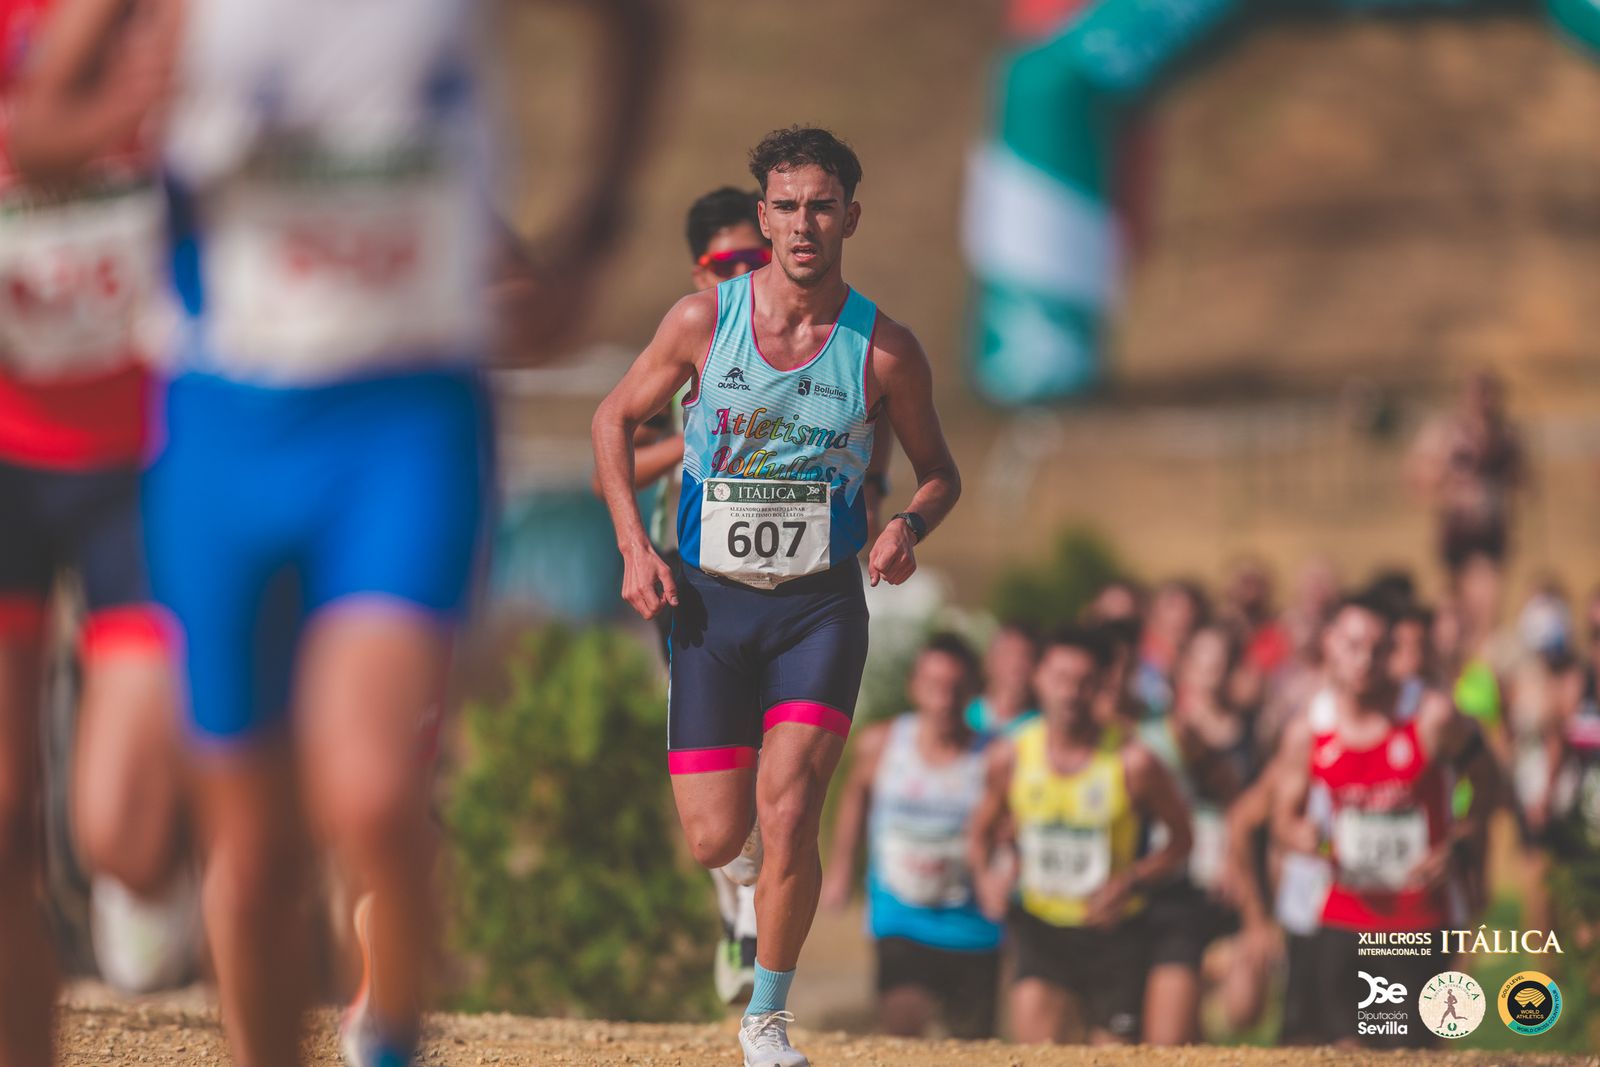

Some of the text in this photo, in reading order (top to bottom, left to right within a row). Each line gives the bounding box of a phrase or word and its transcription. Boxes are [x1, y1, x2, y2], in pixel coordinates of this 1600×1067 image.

[814, 384, 848, 398] Bollullos
[711, 407, 850, 449] Atletismo
[738, 484, 796, 500] ITÁLICA
[727, 521, 807, 558] 607
